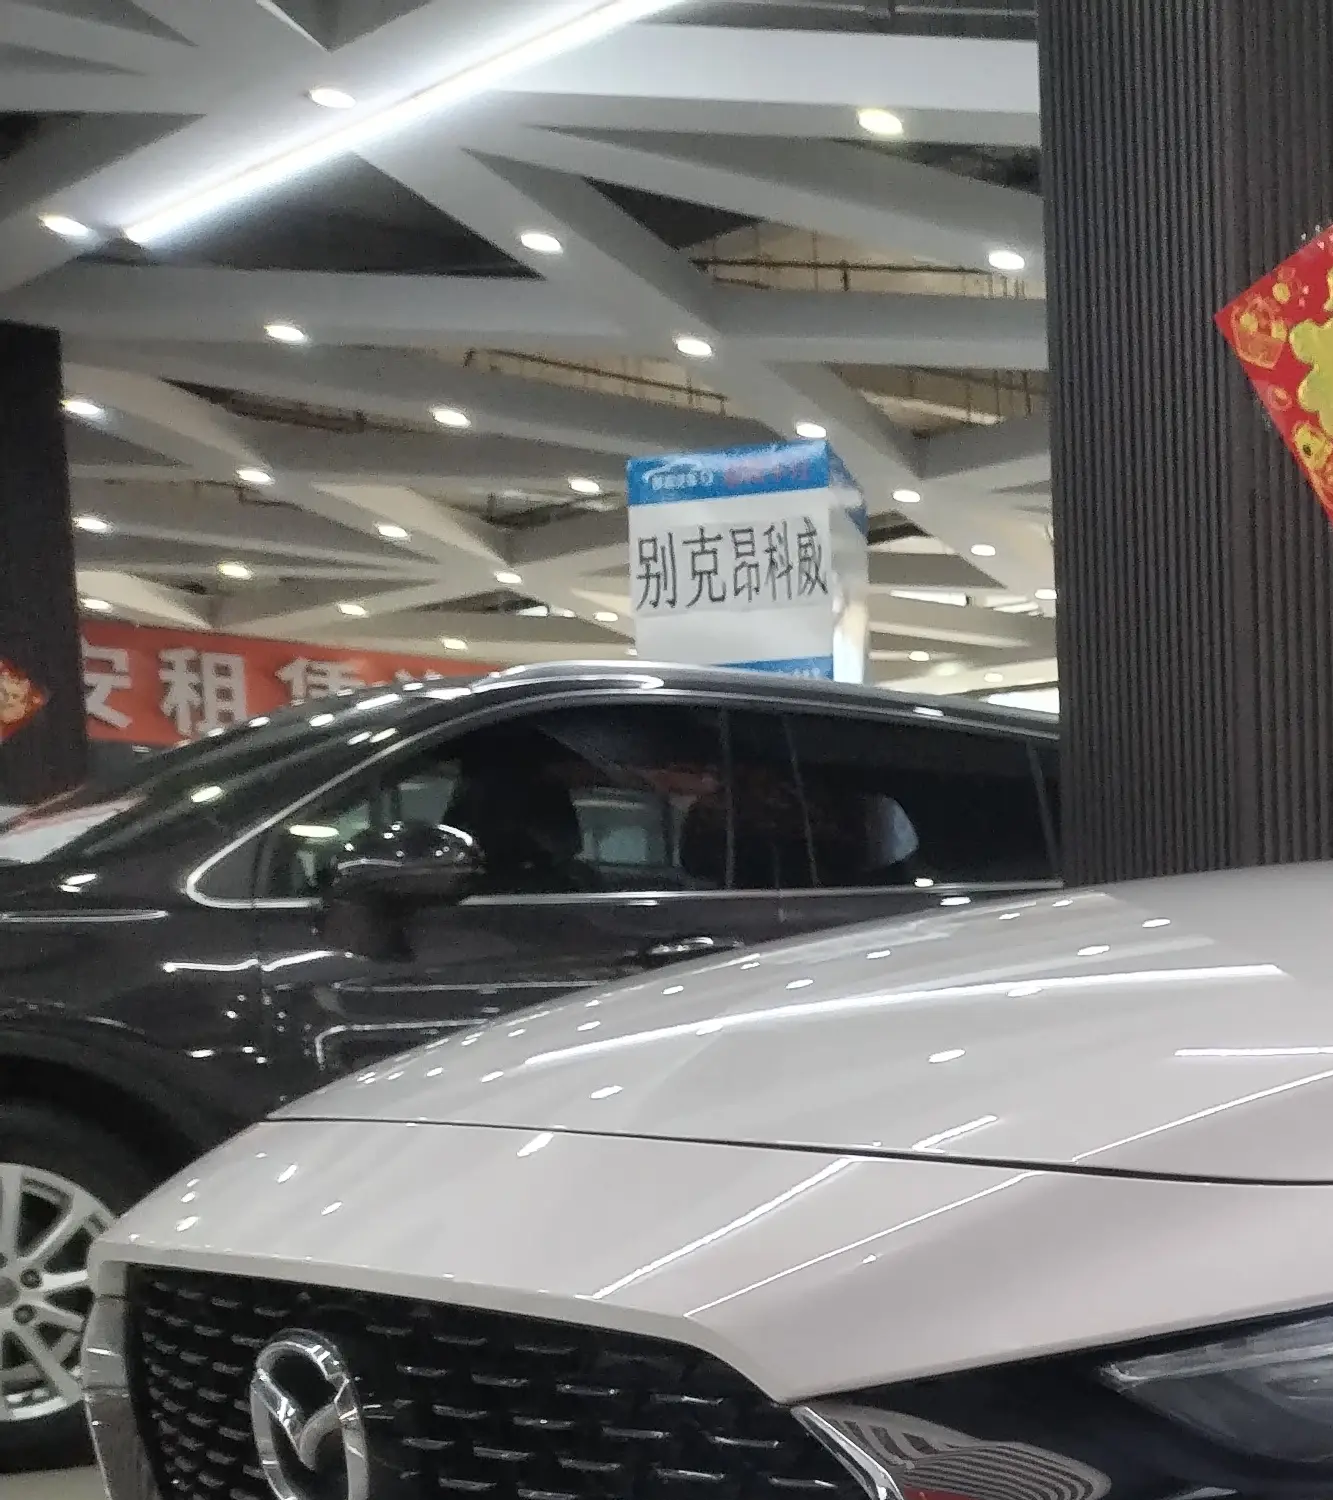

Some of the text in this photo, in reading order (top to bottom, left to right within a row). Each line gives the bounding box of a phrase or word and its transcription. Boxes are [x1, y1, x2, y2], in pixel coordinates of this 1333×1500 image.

[636, 516, 829, 611] 别克昂科威
